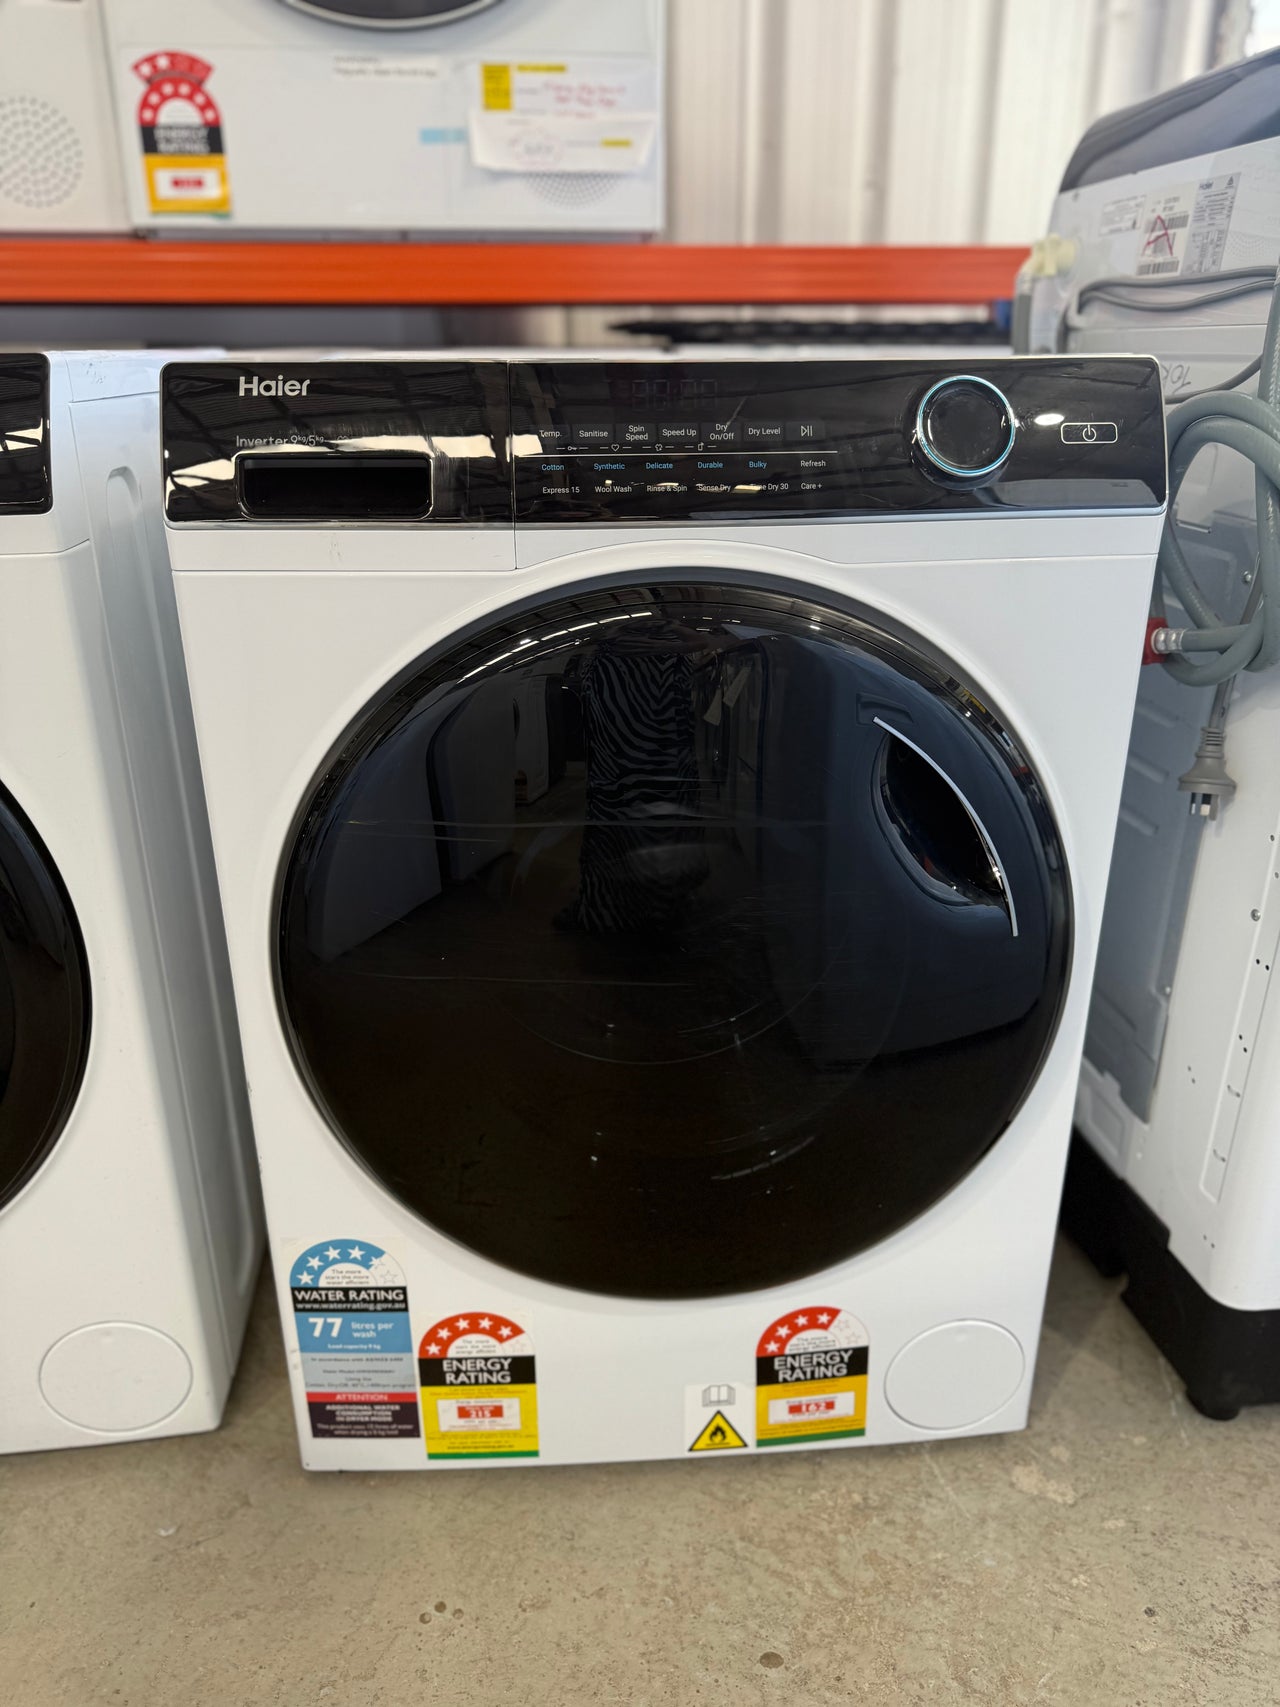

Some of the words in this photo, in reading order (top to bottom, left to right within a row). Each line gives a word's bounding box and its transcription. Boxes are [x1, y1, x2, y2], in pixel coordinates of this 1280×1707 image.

[239, 374, 310, 397] Haier
[628, 424, 645, 434] Spin
[662, 427, 682, 438] Speed
[684, 427, 697, 438] Up
[715, 423, 728, 433] Dry
[748, 427, 760, 437] Dry
[761, 426, 781, 436] Level
[539, 429, 562, 439] Temp.
[579, 429, 609, 438] Sanitise
[625, 432, 648, 442] Speed
[709, 431, 735, 441] On/Off
[236, 435, 288, 448] Inverter
[541, 463, 565, 471] Cotton
[593, 462, 625, 472] Synthetic
[645, 461, 673, 470] Delicate
[697, 460, 724, 469] Durable
[749, 460, 767, 470] Bulky
[800, 459, 826, 468] Refresh
[542, 486, 569, 495] Express
[594, 485, 611, 493] Wool
[612, 485, 632, 493] Wash
[646, 484, 665, 492] Rinse
[666, 484, 673, 492] &
[673, 484, 687, 494] Spin
[698, 484, 718, 493] Sense
[719, 483, 731, 494] Dry
[767, 483, 779, 492] Dry
[800, 482, 816, 490] Care
[294, 1290, 345, 1301] WATER
[349, 1289, 404, 1301] RATING
[295, 1301, 406, 1311] www.waterrating.gov.au
[308, 1317, 343, 1338] 77
[351, 1321, 375, 1330] litres
[377, 1322, 394, 1331] per
[352, 1330, 376, 1338] wash
[442, 1358, 512, 1372] ENERGY
[773, 1350, 853, 1370] ENERGY
[778, 1363, 848, 1382] RATING
[445, 1371, 511, 1385] RATING
[336, 1393, 388, 1401] ATTENTION
[801, 1402, 827, 1412] 162
[469, 1410, 491, 1419] 215
